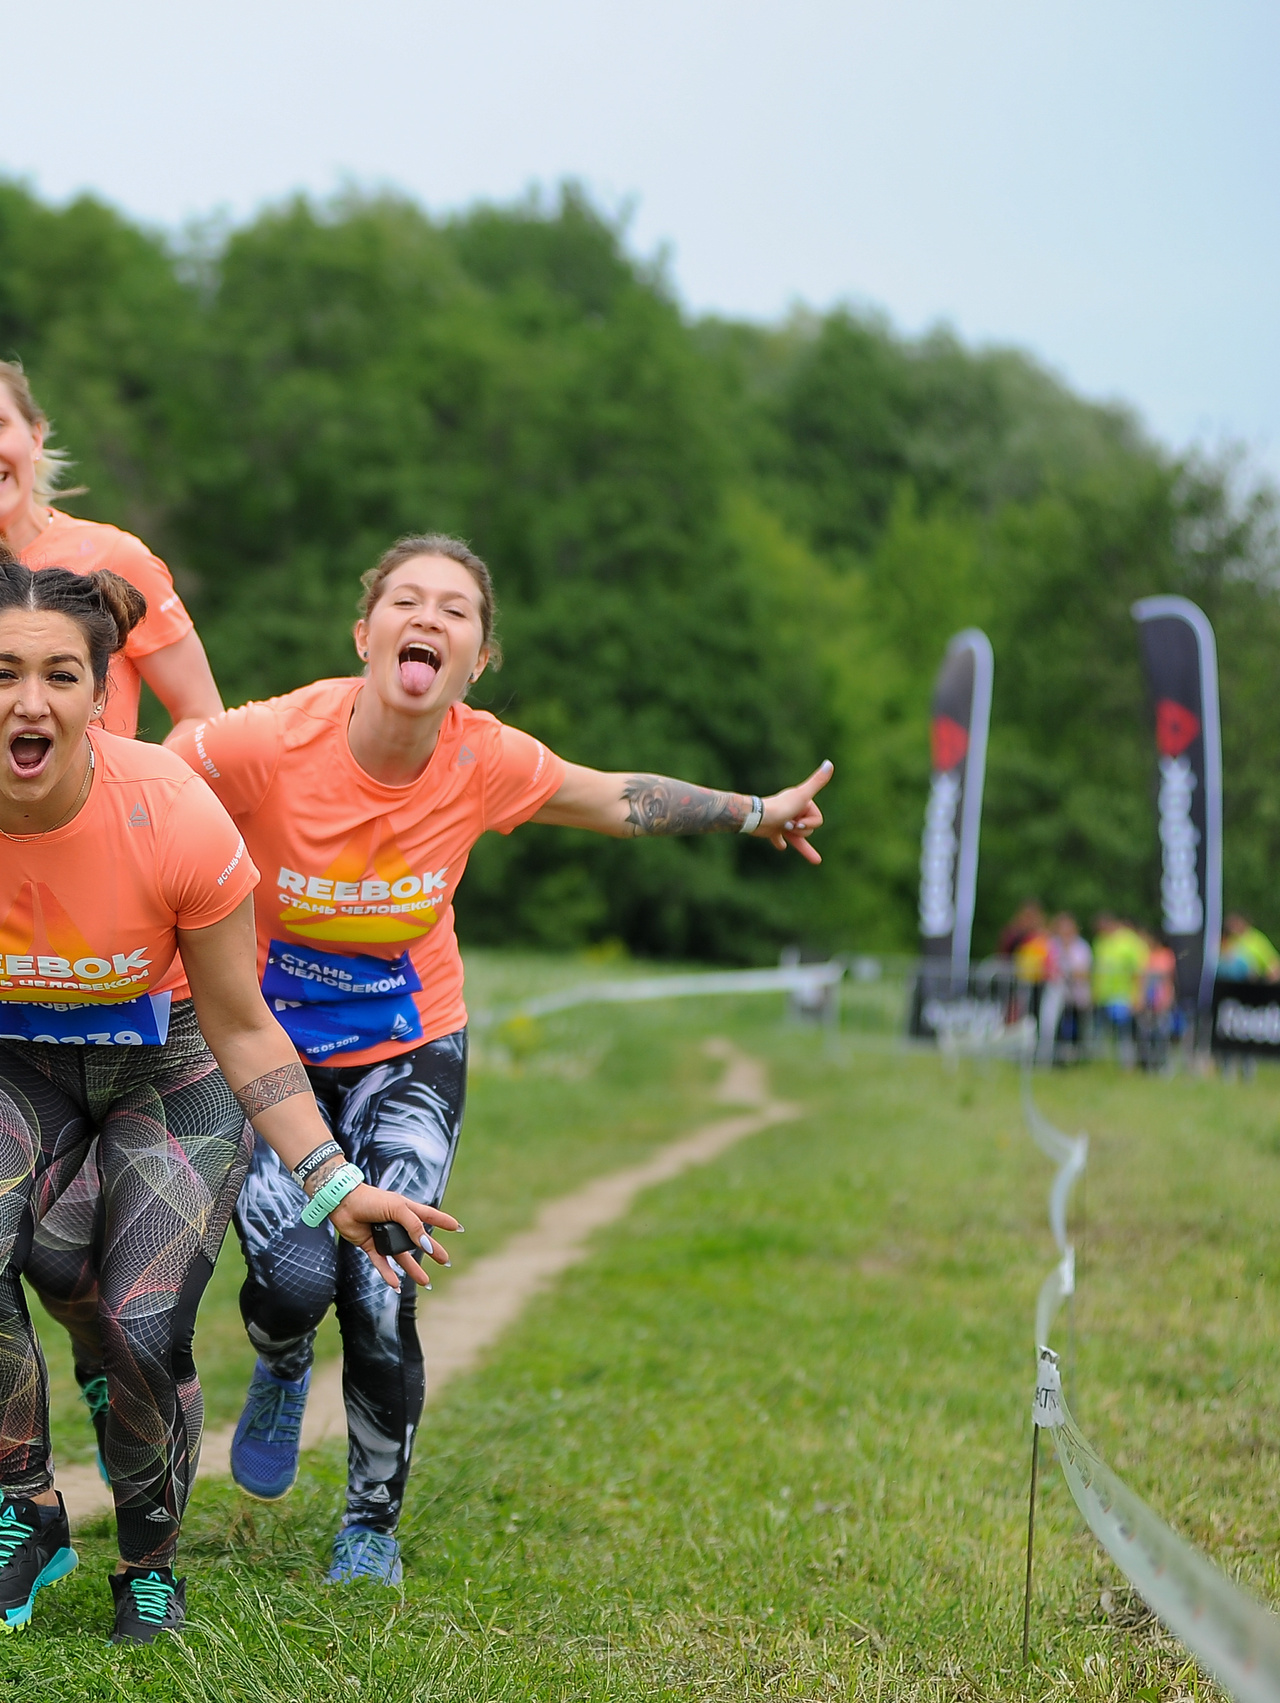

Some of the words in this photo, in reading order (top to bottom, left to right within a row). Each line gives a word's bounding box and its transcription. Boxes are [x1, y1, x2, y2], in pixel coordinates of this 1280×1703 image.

[276, 866, 450, 902] REEBOK
[278, 893, 337, 915] СТАНЬ
[341, 894, 444, 915] ЧЕЛОВЕКОМ
[280, 962, 407, 994] ЧЕЛОВЕКОМ
[281, 953, 353, 981] СТАНЬ
